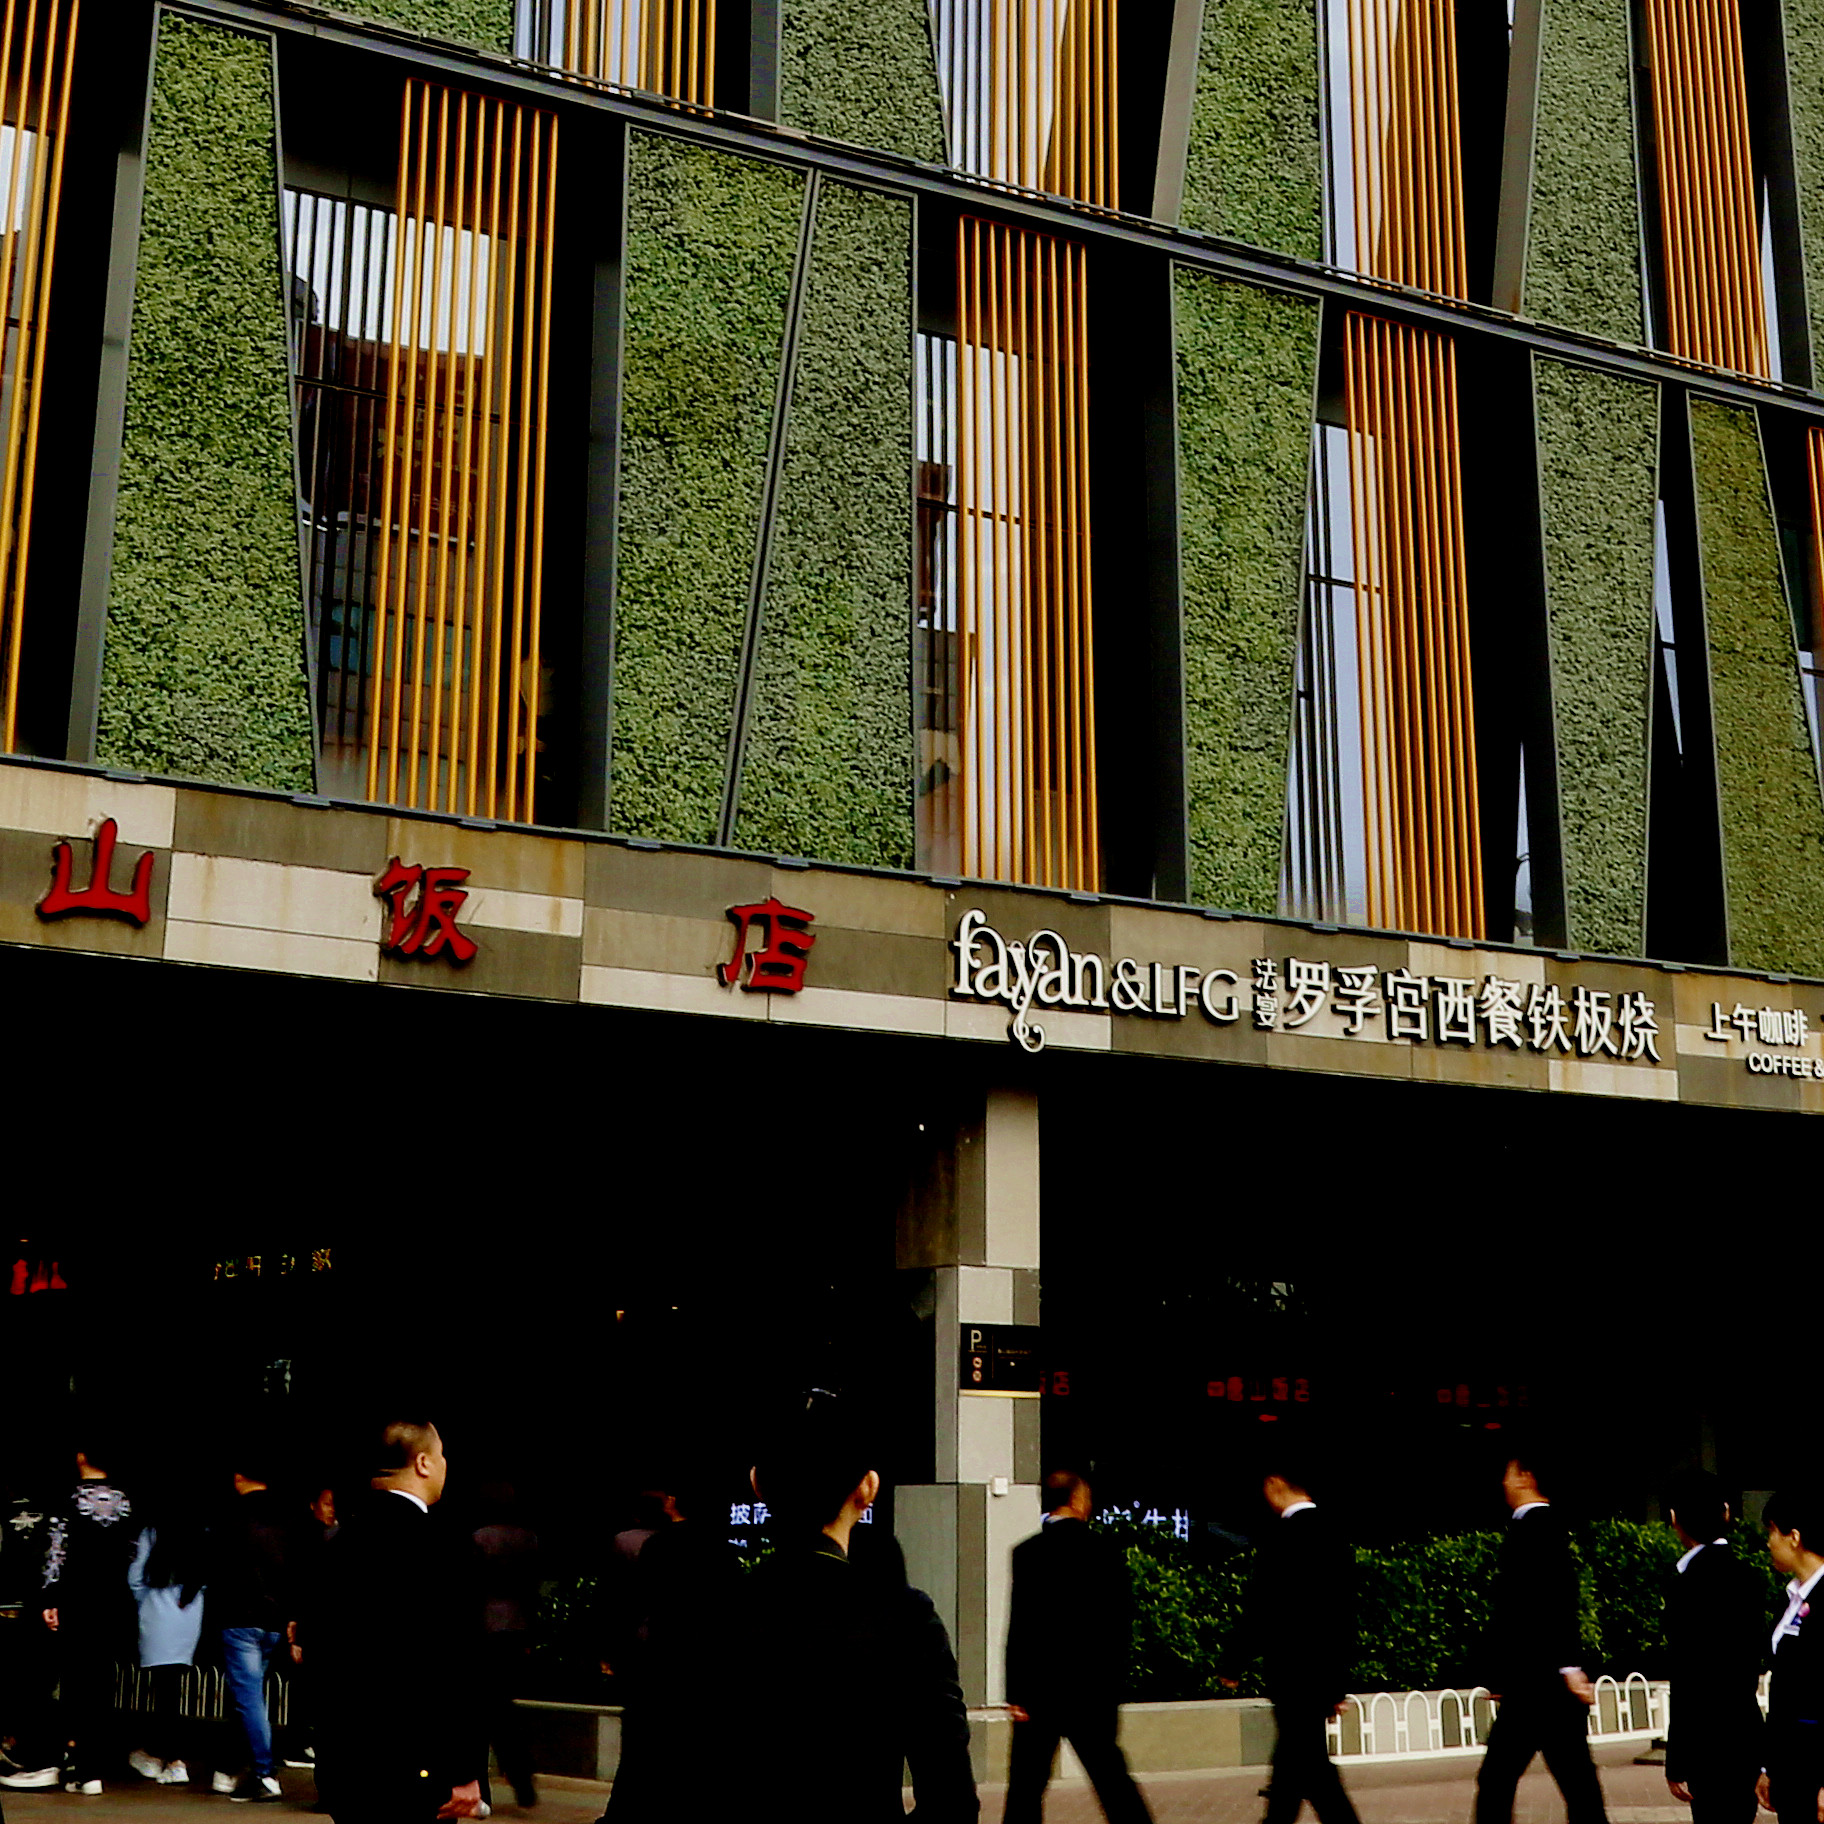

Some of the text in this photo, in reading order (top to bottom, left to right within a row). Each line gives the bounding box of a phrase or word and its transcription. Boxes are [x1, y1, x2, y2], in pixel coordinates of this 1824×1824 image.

[1287, 957, 1662, 1062] 罗孚宫西餐铁板烧
[1706, 1001, 1809, 1047] 上午咖啡
[1749, 1051, 1813, 1077] COFFEE
